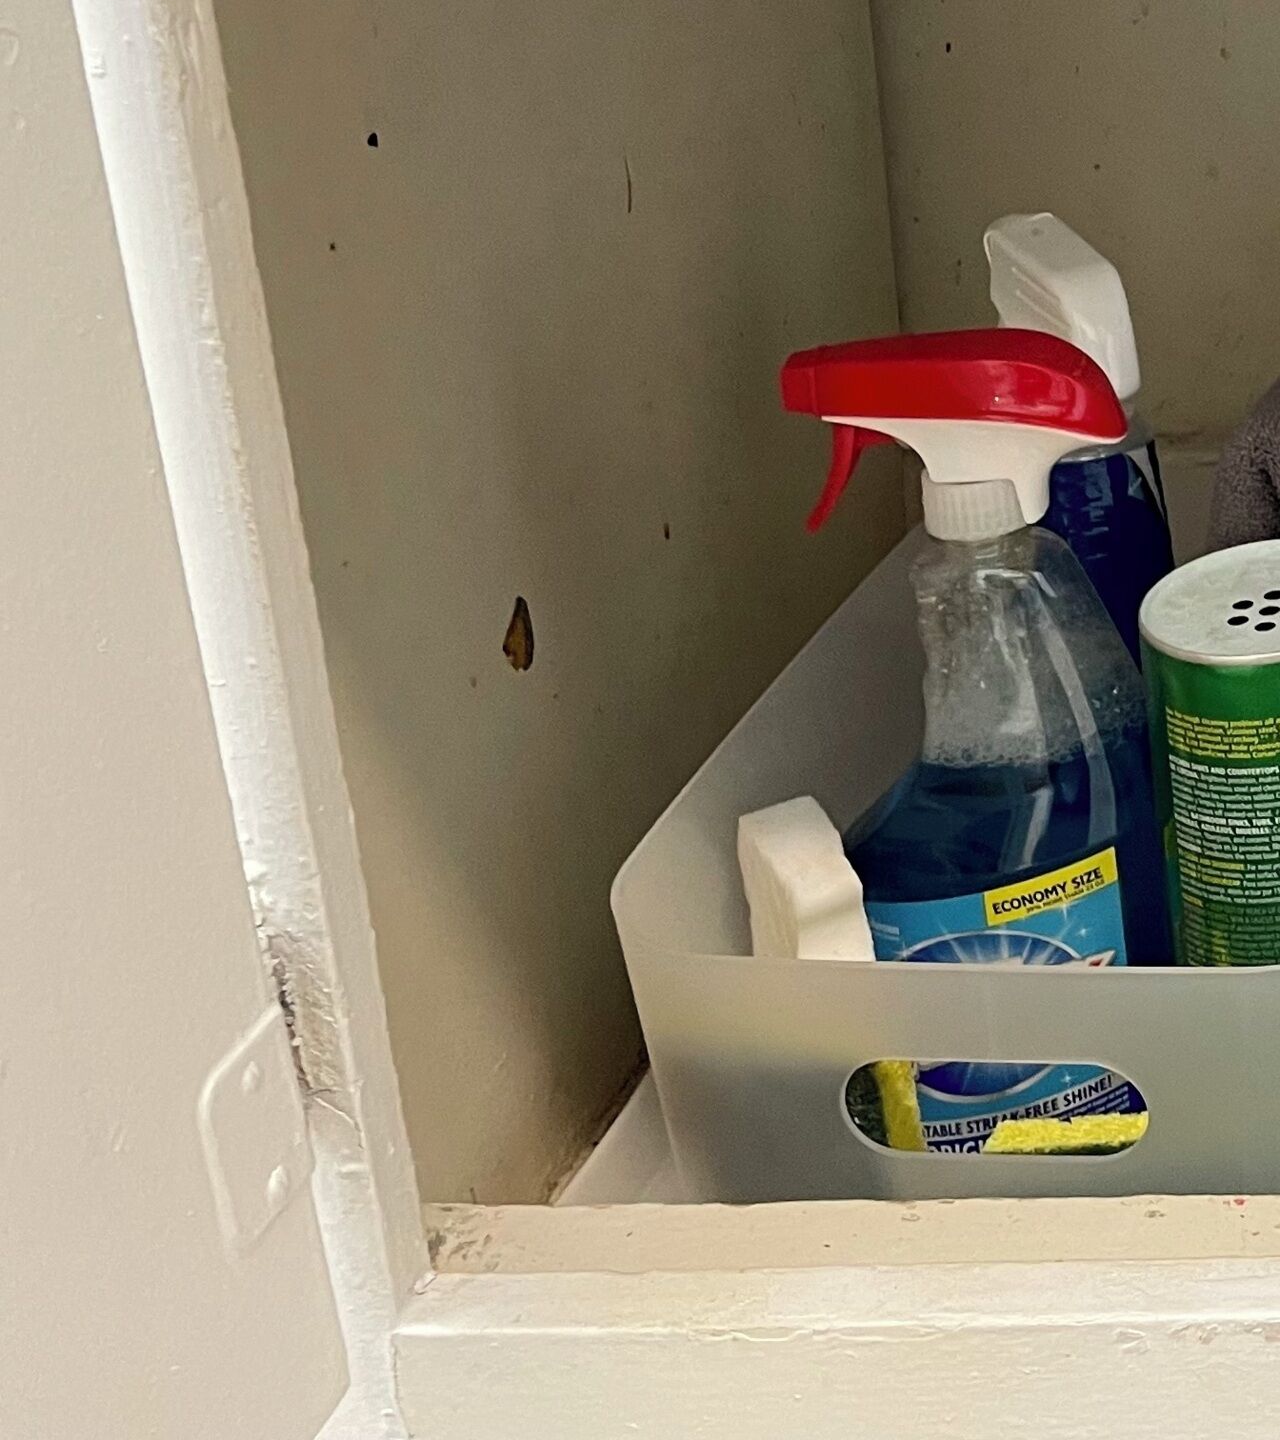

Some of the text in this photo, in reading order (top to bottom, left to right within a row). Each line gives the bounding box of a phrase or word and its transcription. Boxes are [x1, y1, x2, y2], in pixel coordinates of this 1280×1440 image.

[992, 867, 1103, 915] ECONOMY SIZE
[923, 1122, 962, 1138] TABLE
[1064, 1074, 1113, 1107] SHINE!
